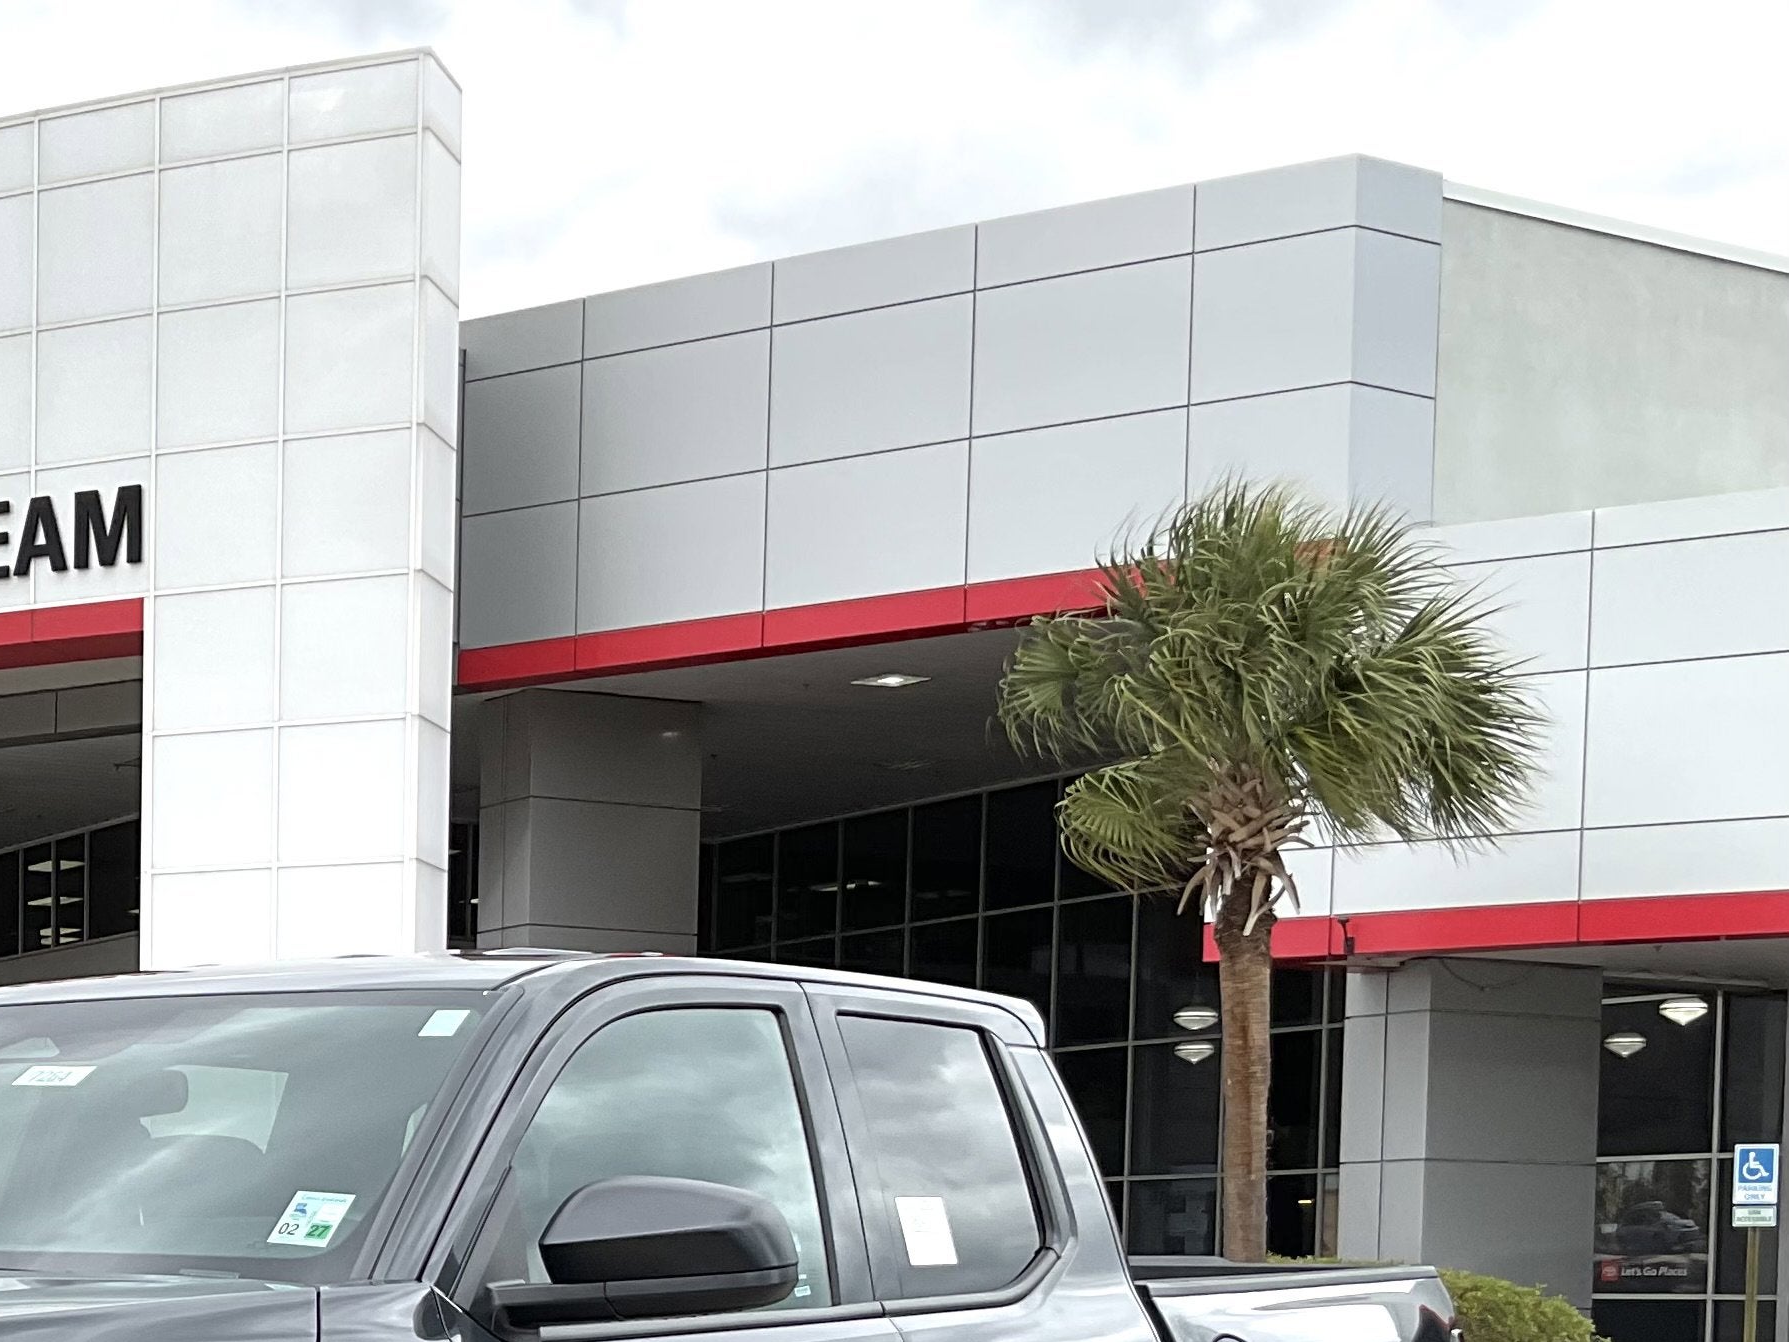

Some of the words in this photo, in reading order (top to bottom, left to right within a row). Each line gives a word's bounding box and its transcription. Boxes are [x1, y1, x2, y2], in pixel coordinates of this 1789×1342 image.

[278, 1222, 300, 1236] 02
[306, 1224, 332, 1238] 27
[1643, 1266, 1657, 1276] Go
